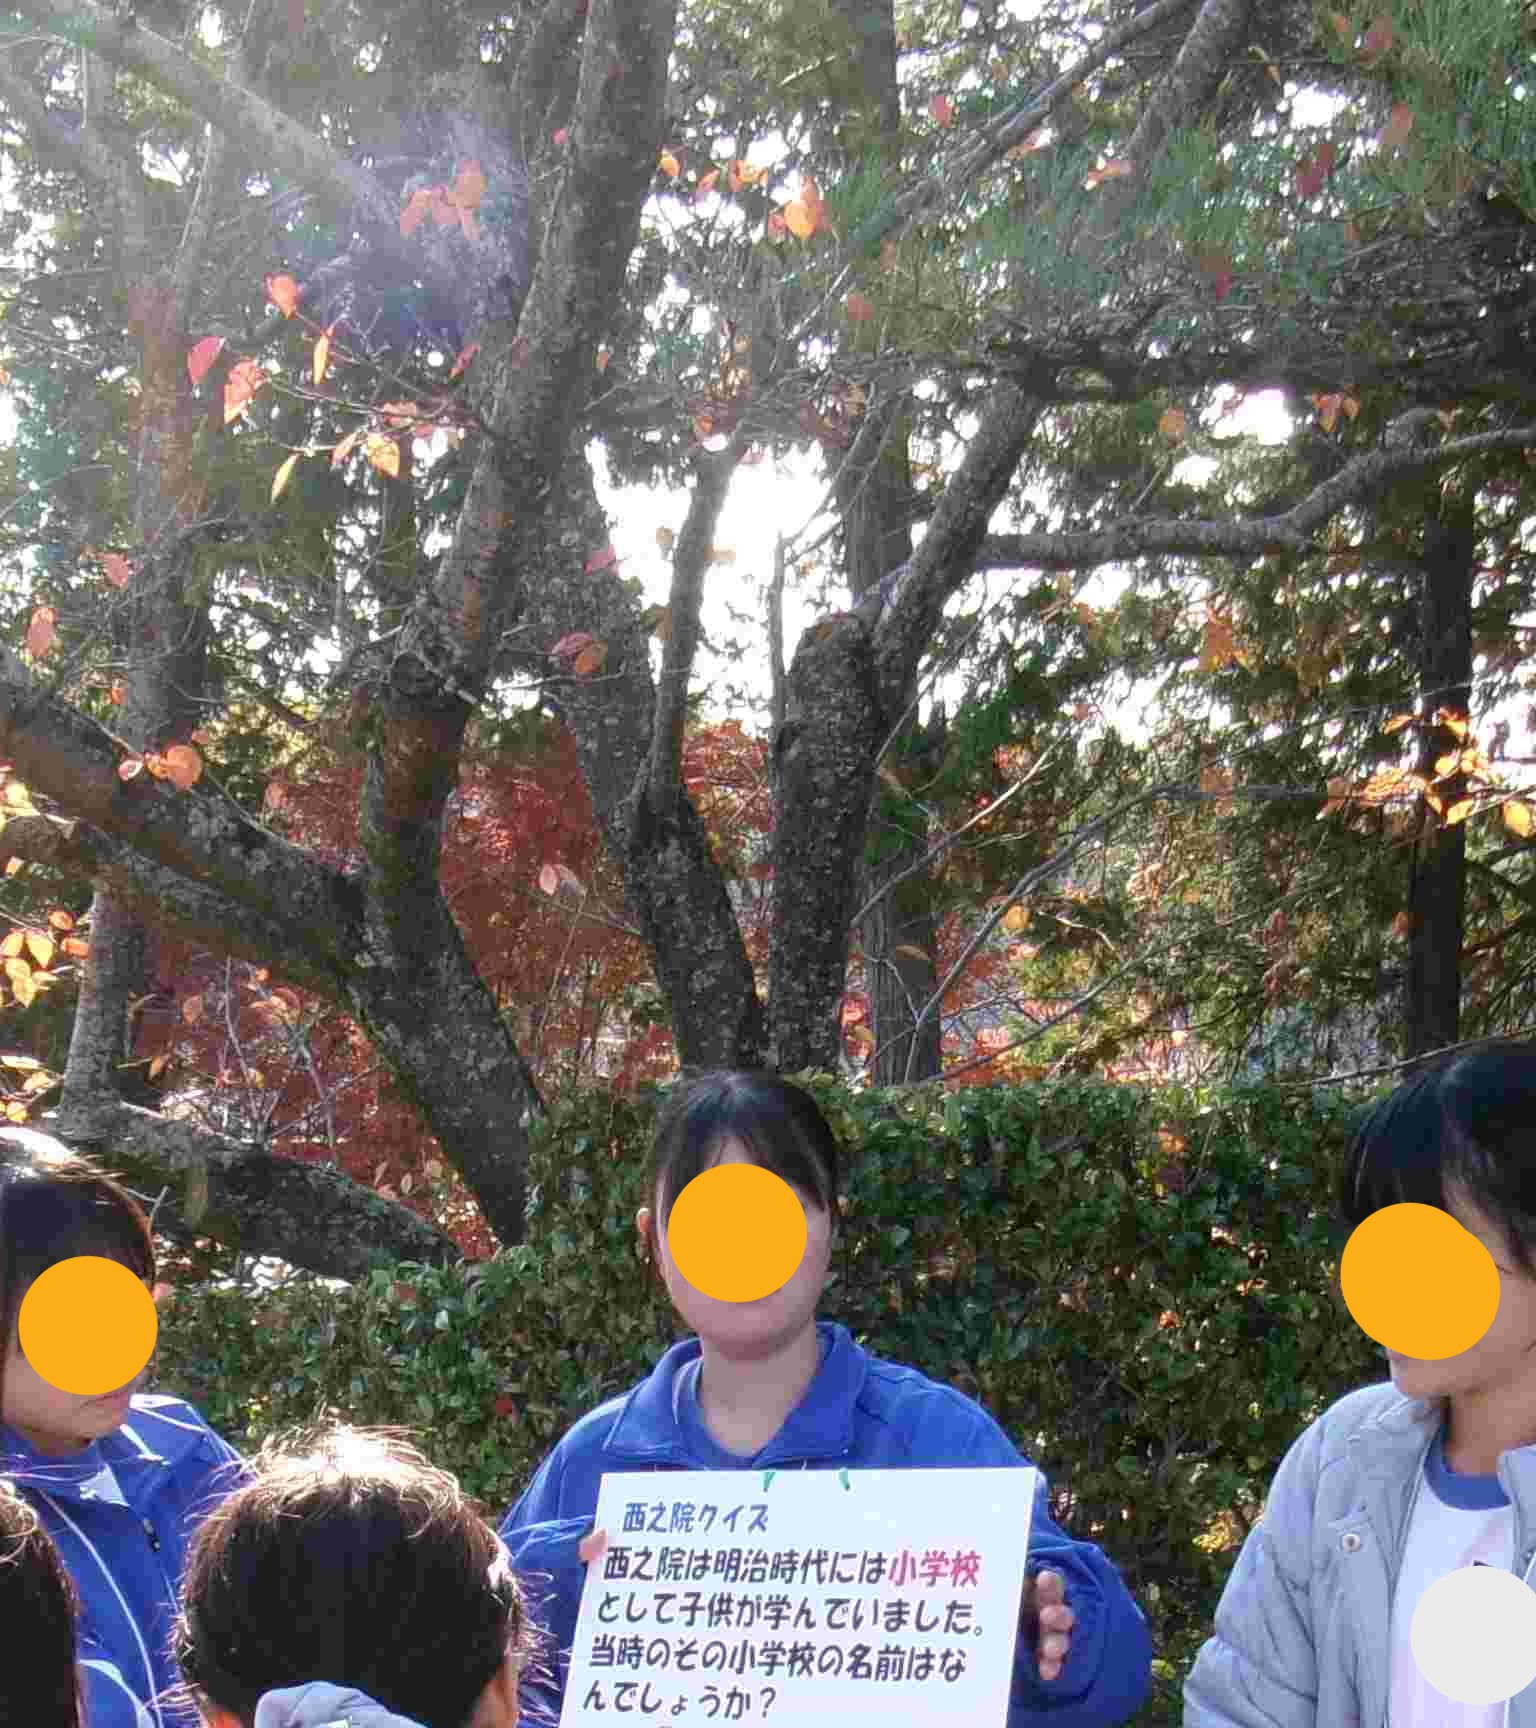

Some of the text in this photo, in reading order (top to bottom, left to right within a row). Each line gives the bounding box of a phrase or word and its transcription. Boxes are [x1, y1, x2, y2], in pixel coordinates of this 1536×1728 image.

[622, 1501, 768, 1533] 西之院クイズ
[589, 1634, 966, 1682] 当時のその小学校の名前はな
